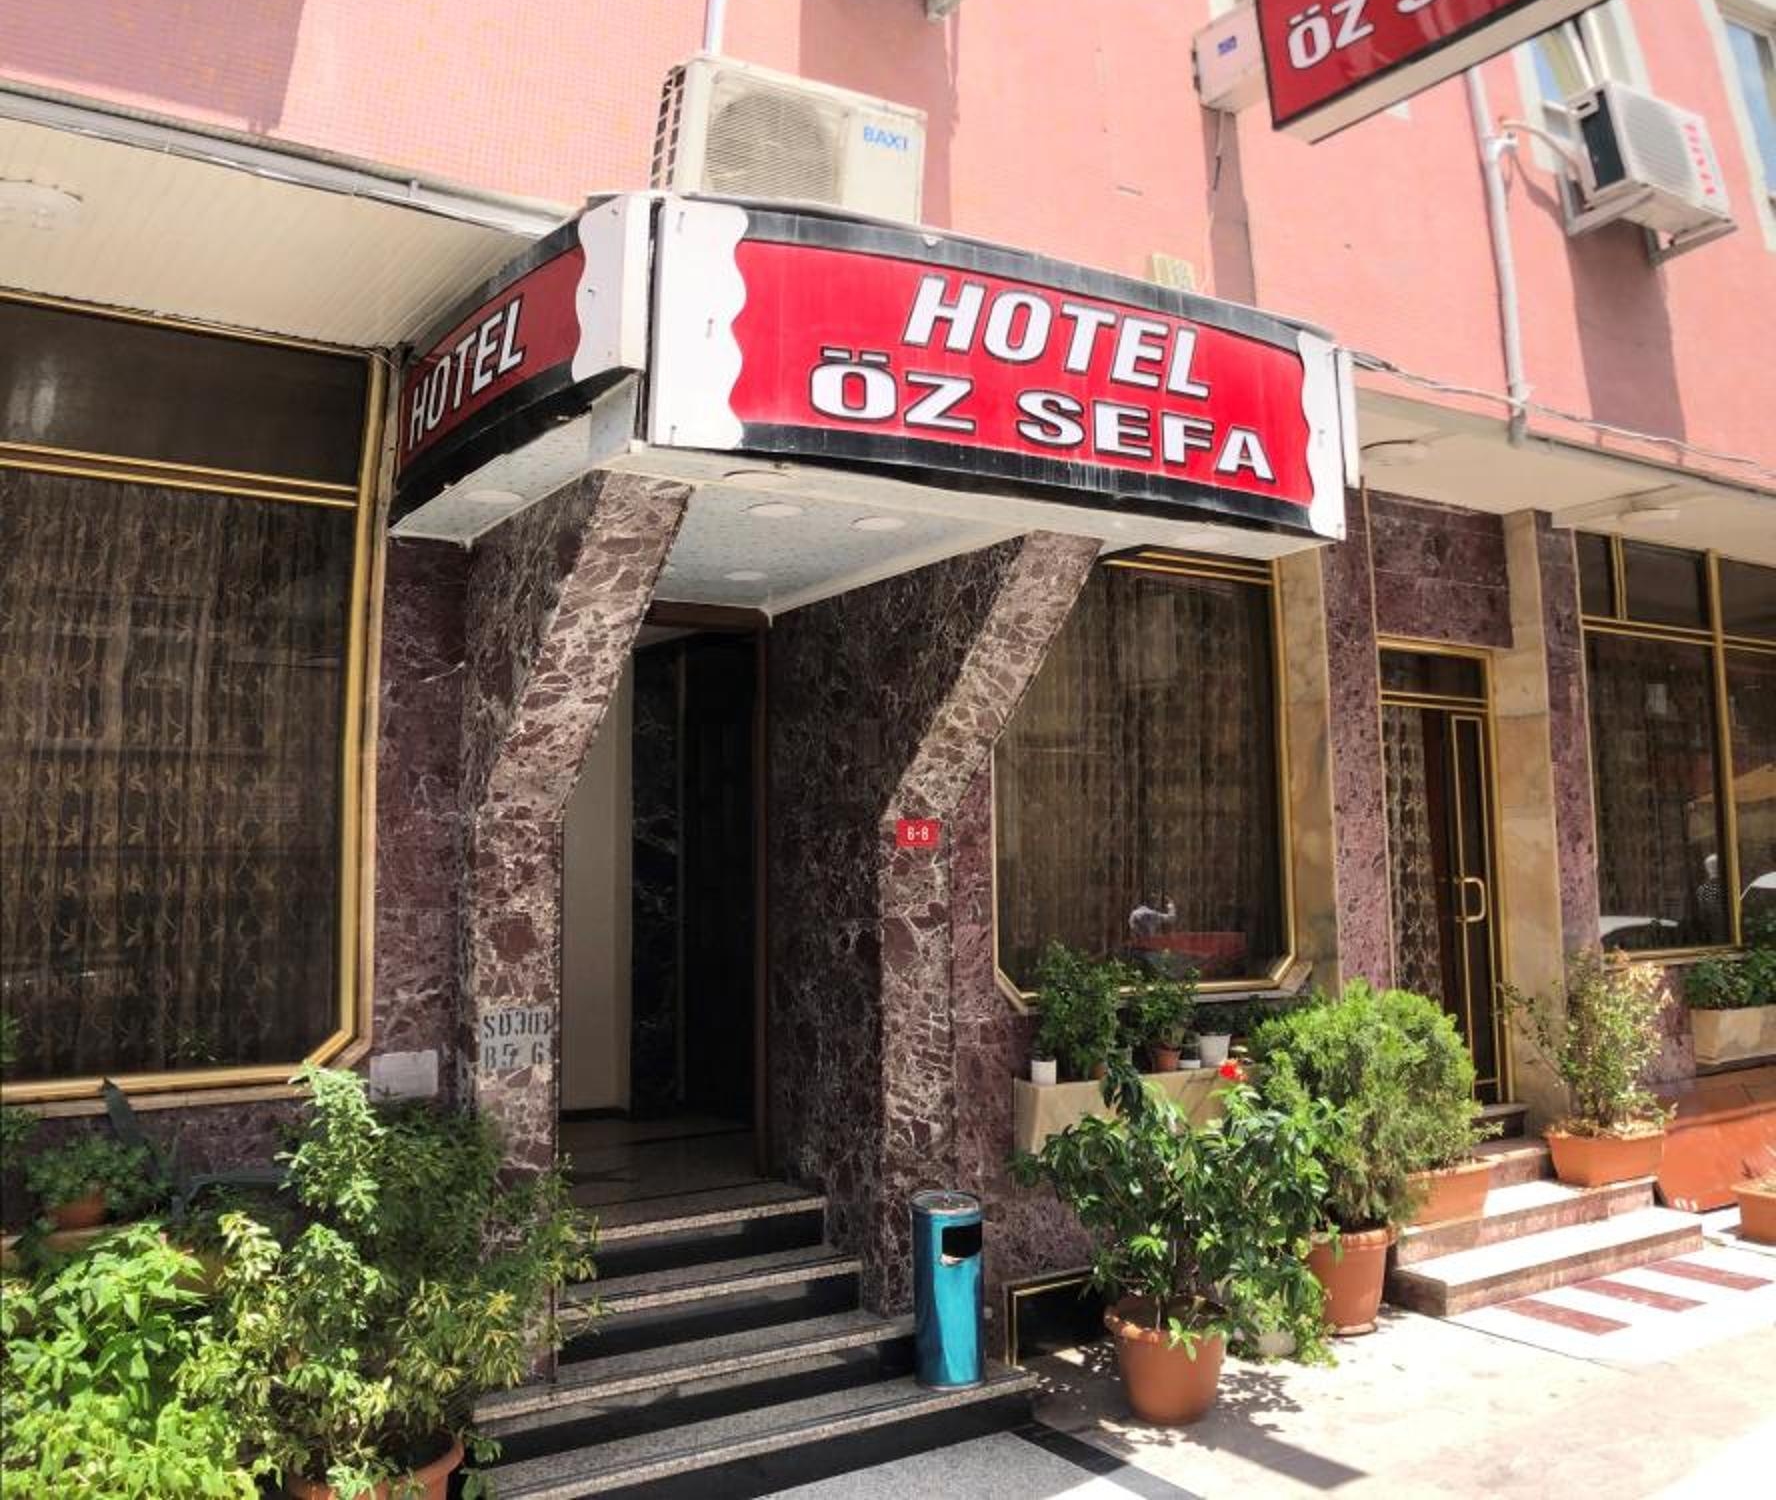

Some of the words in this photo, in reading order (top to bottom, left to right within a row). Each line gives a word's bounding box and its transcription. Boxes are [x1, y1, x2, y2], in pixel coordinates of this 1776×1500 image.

[863, 125, 908, 150] BAXI
[409, 296, 525, 449] HOTEL
[902, 274, 1211, 398] HOTEL
[809, 348, 976, 432] ÖZ
[1016, 389, 1277, 482] SEFA
